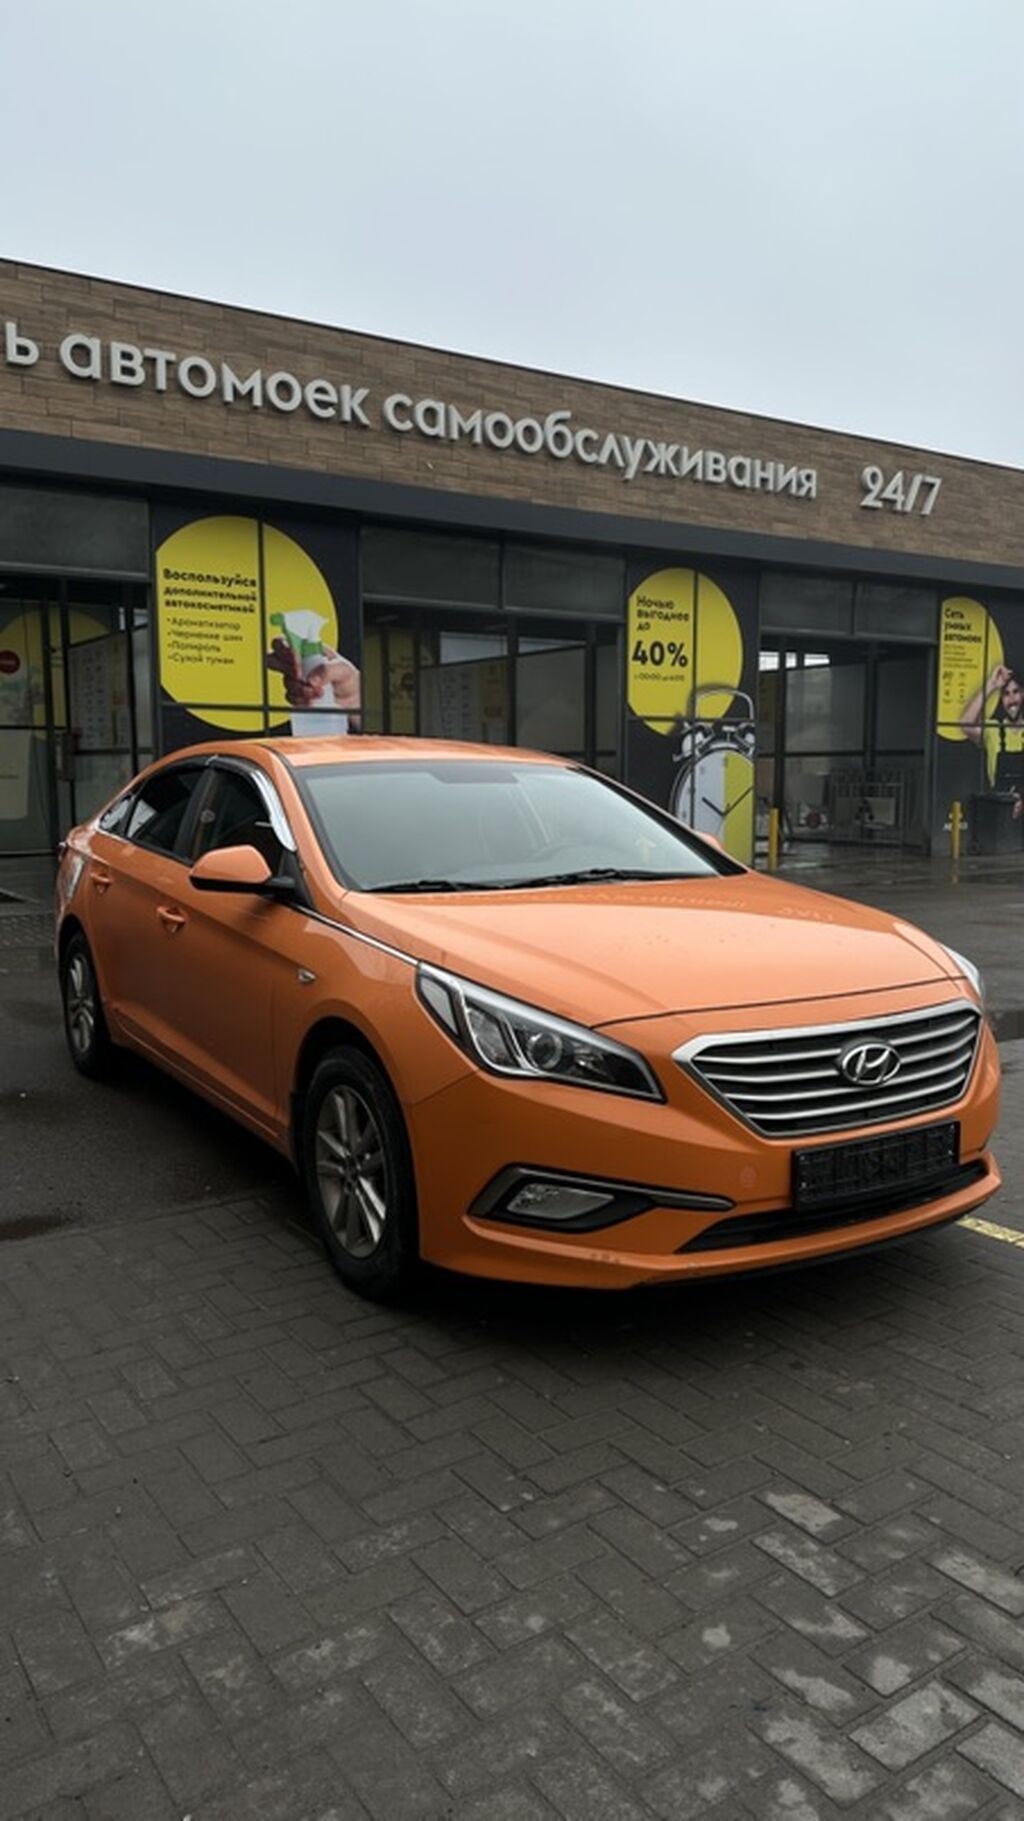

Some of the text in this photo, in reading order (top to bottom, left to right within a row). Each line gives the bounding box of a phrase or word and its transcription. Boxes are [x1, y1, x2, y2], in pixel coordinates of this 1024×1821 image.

[5, 321, 943, 516] ь автомоек самообслуживания 24/7
[163, 568, 257, 587] Воспользуйся
[164, 587, 257, 601] дополнительной
[165, 600, 255, 613] автокосметикой
[637, 595, 675, 610] Ночью
[637, 609, 690, 622] выгоднее
[637, 621, 651, 632] до
[632, 640, 688, 668] 40%
